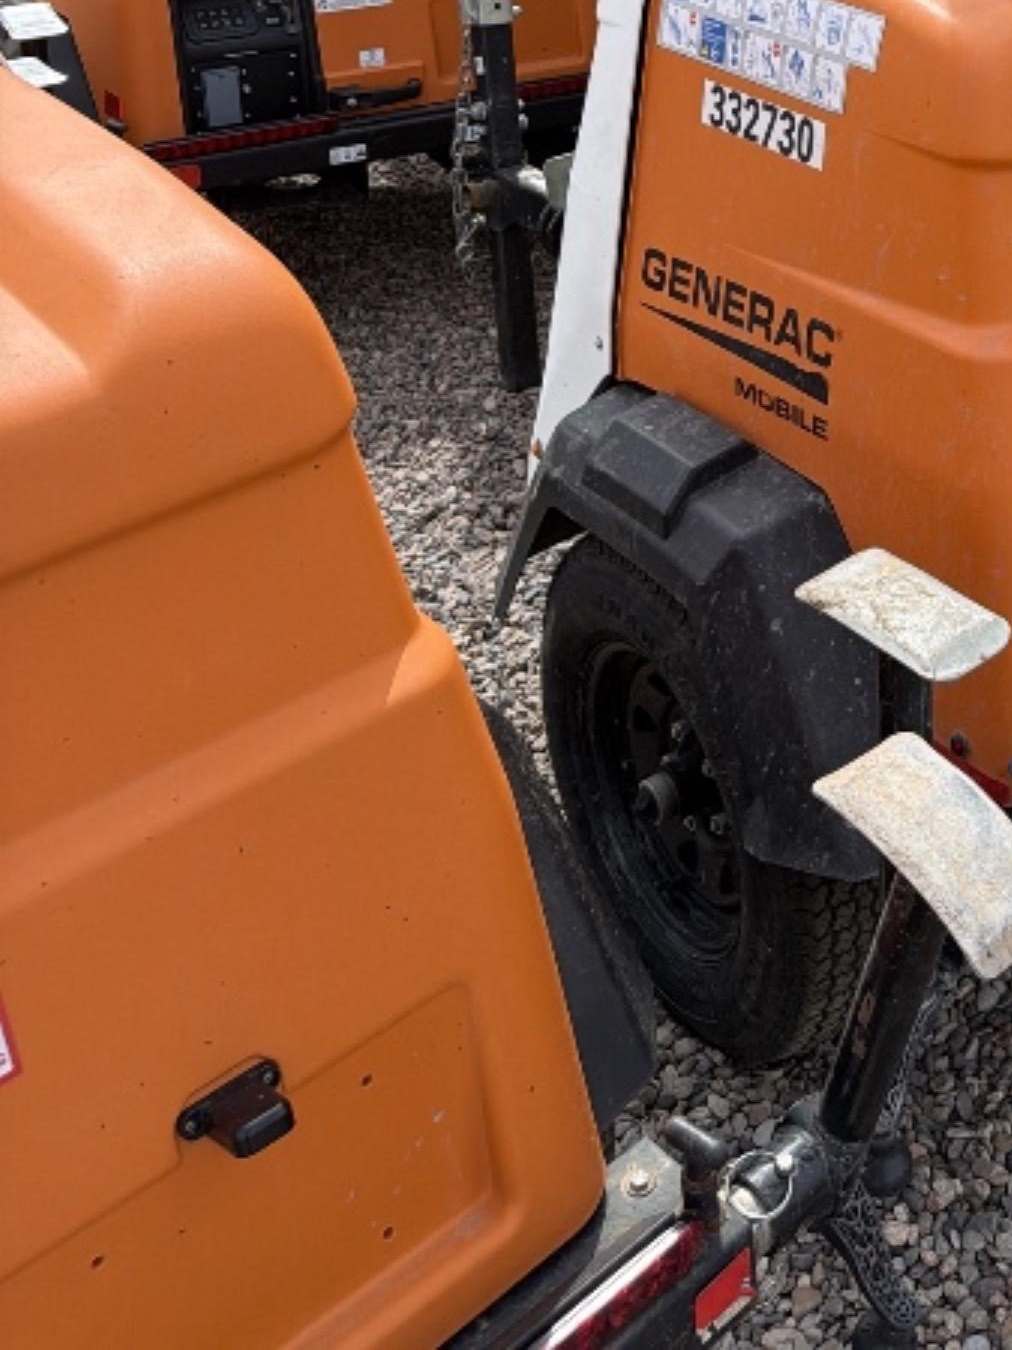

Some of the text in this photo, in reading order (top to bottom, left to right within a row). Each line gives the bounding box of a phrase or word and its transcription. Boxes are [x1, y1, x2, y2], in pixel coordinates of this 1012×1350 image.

[708, 82, 814, 163] 332730
[641, 247, 835, 368] GENERAC
[734, 376, 829, 441] MOBILE
